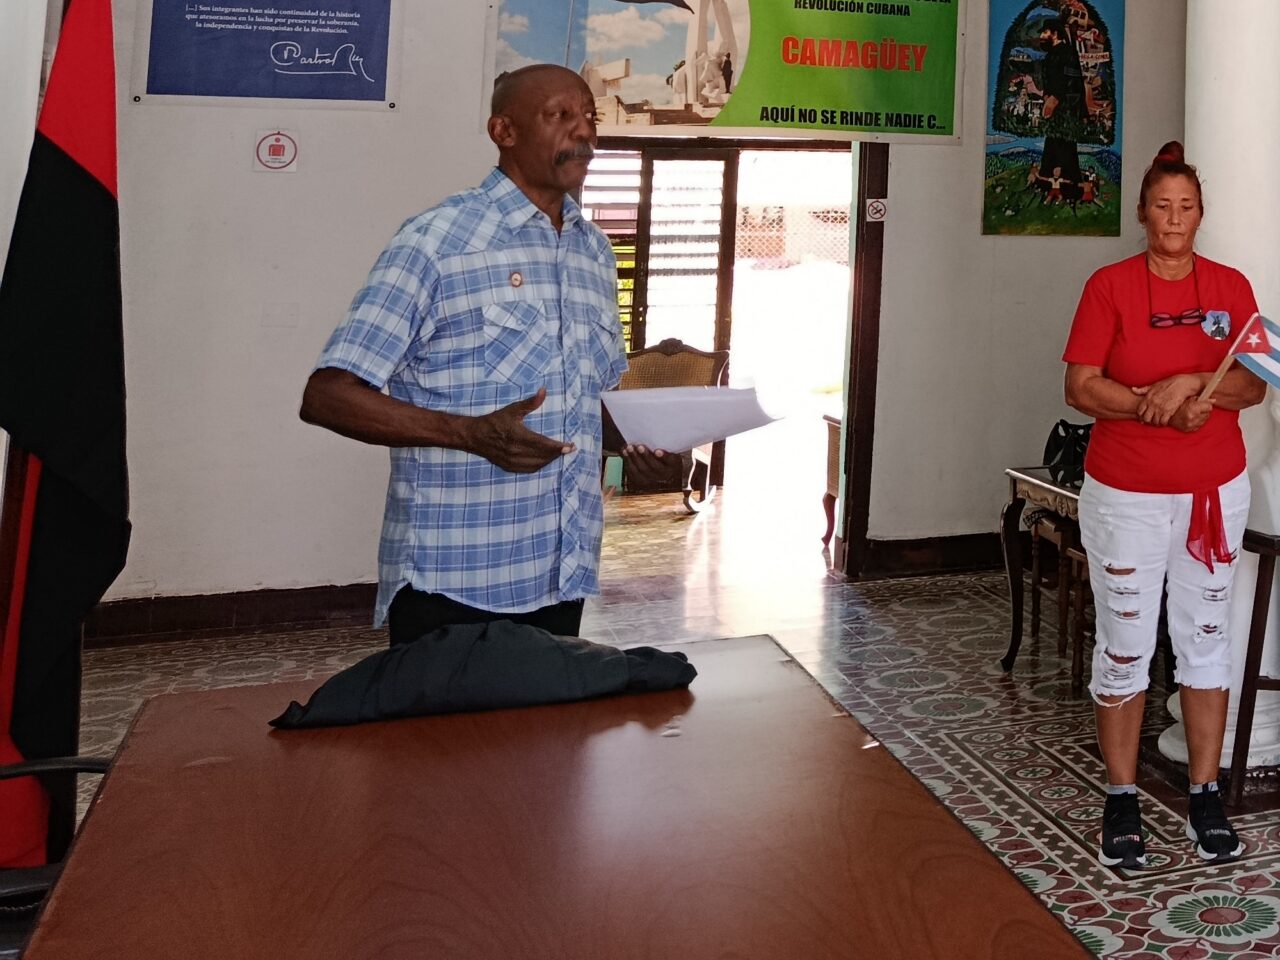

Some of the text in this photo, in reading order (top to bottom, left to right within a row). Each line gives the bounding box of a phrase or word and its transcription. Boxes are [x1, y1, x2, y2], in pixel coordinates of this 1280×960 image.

[212, 5, 249, 14] integrantes
[264, 7, 278, 15] sido
[335, 10, 361, 18] historia
[866, 1, 911, 17] CUBANA
[255, 15, 274, 23] lucha
[203, 21, 252, 30] independencia
[258, 24, 293, 33] conquistas
[781, 35, 928, 72] CAMAGÜEY
[759, 104, 795, 124] AQUÍ
[798, 108, 818, 124] NO
[820, 109, 837, 125] SE
[840, 110, 882, 127] RINDE
[884, 112, 925, 129] NADIE
